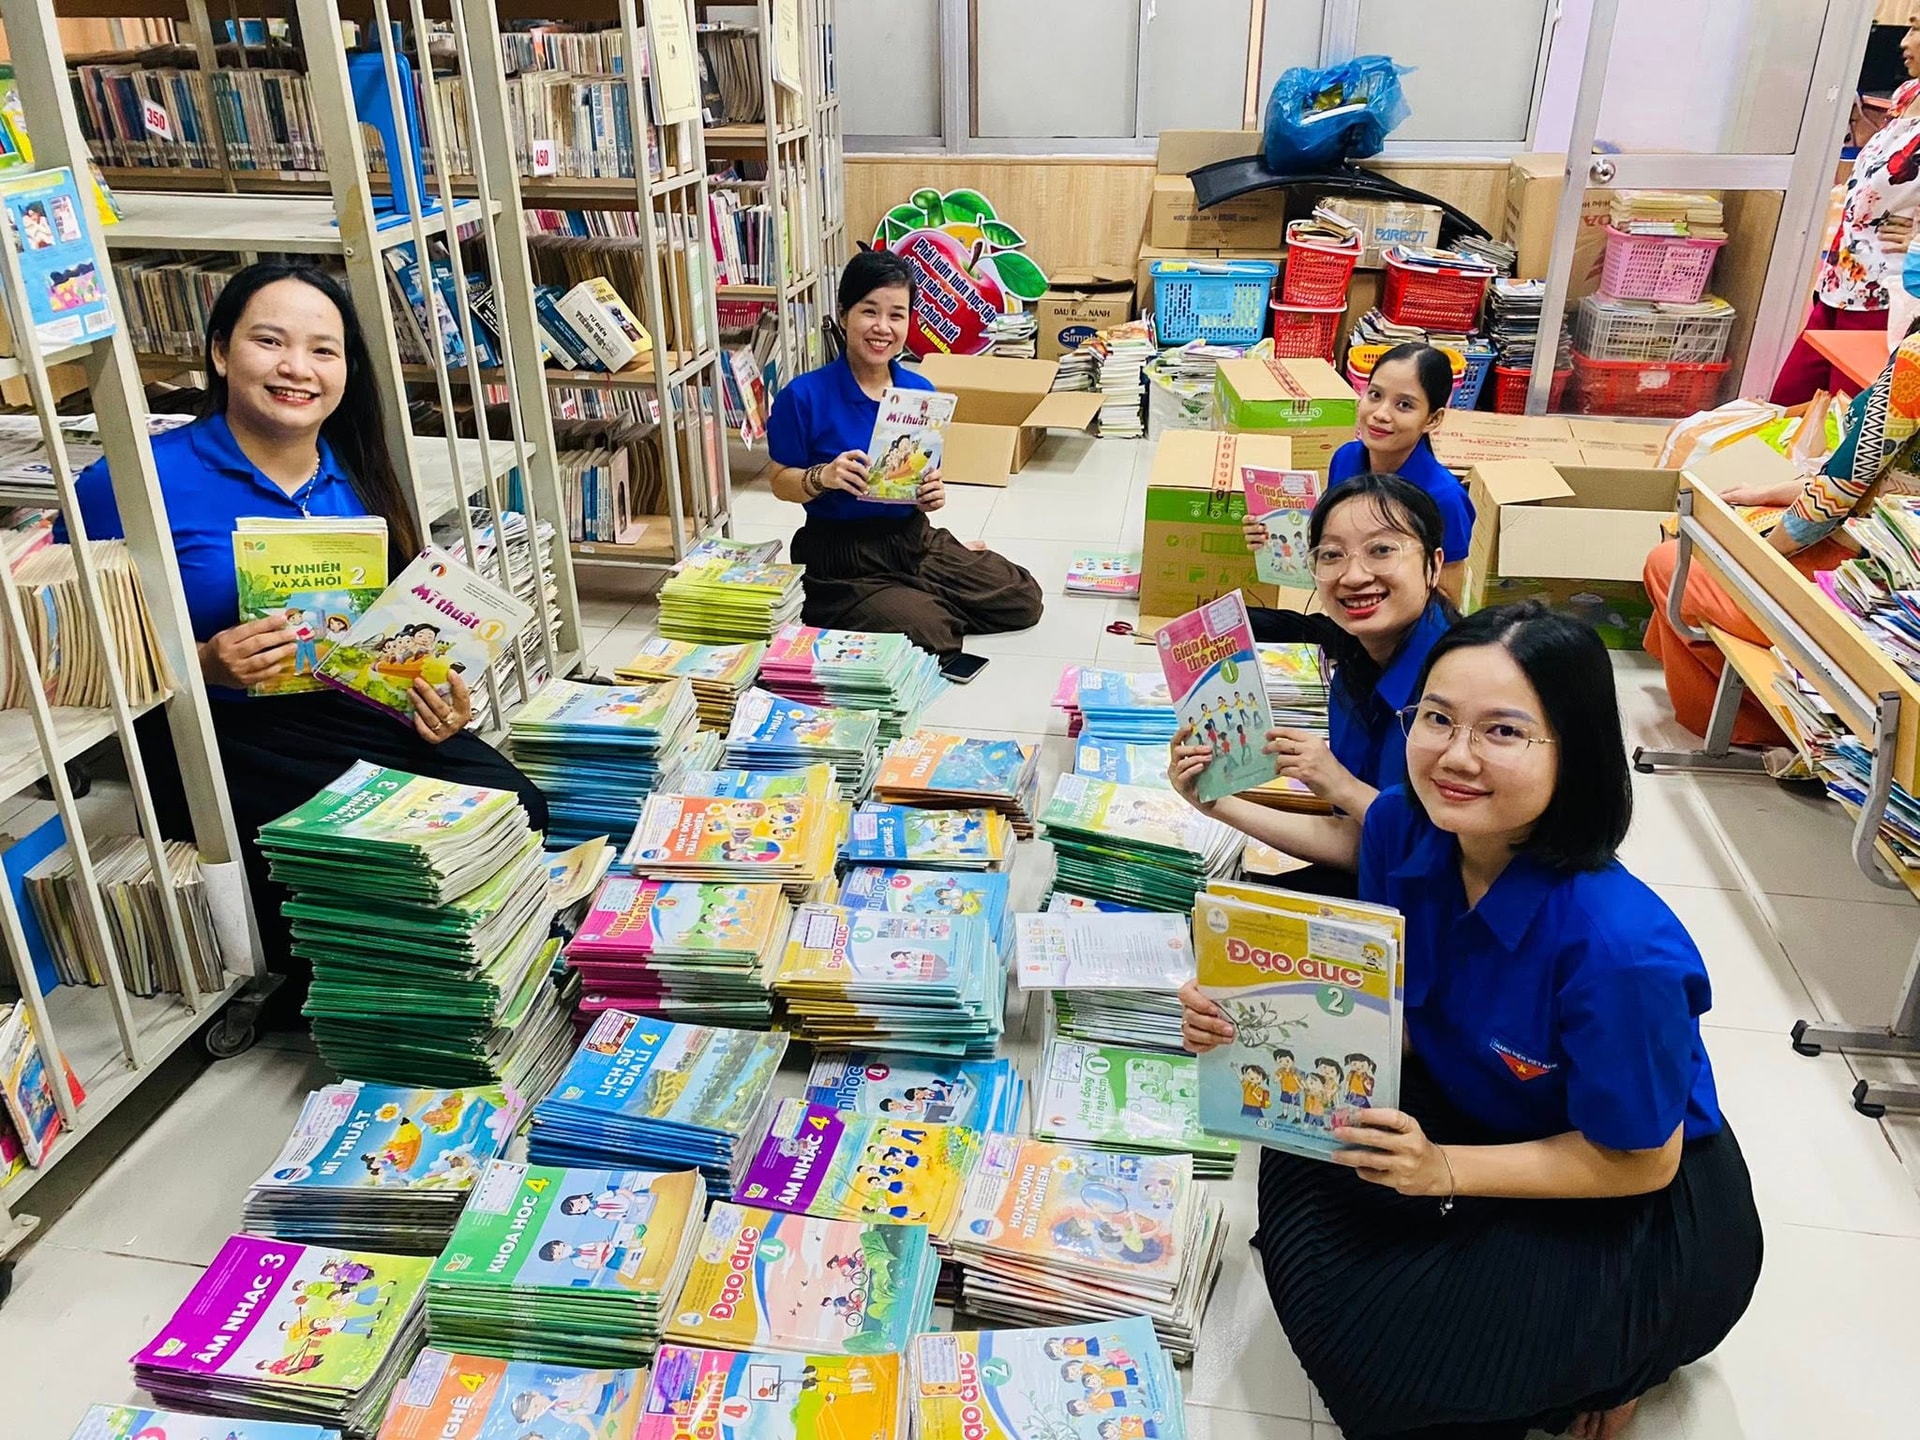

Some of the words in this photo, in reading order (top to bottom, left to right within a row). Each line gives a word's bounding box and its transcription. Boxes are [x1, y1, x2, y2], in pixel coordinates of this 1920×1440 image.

[146, 108, 166, 130] 350
[535, 149, 549, 167] 450
[1375, 227, 1428, 243] PARROT
[924, 274, 941, 295] nào
[938, 289, 958, 313] còn
[932, 256, 953, 279] luôn
[949, 272, 970, 297] luôn
[966, 288, 983, 310] học
[919, 302, 943, 327] chưa
[938, 318, 960, 342] biết
[1291, 512, 1300, 525] 2
[270, 563, 292, 578] TỰ
[294, 560, 341, 575] NHIÊN
[273, 579, 288, 589] VÀ
[291, 575, 311, 588] XÃ
[314, 573, 342, 589] HỘI
[350, 566, 367, 586] 2
[411, 583, 441, 604] Mĩ
[435, 598, 481, 630] thuật
[486, 624, 500, 640] 1
[1172, 639, 1201, 662] Giáo
[1227, 662, 1236, 681] 1
[910, 754, 932, 778] TOÁN
[923, 747, 937, 757] 3
[377, 780, 399, 790] 3
[715, 774, 731, 783] 2
[679, 812, 693, 833] ĐỘNG
[690, 812, 706, 840] NGHIỆM
[879, 817, 896, 825] 3
[675, 832, 689, 851] HOẠT
[686, 839, 699, 856] TRẢI
[866, 877, 891, 899] học
[894, 876, 908, 887] 3
[657, 898, 677, 907] 3
[853, 930, 872, 939] 3
[827, 948, 845, 969] Đạo
[1225, 937, 1294, 974] Đạo
[1326, 987, 1344, 1013] 2
[639, 1033, 661, 1046] 4
[634, 1049, 653, 1062] LÍ
[1089, 1061, 1109, 1069] 1
[595, 1066, 625, 1096] LỊCH
[615, 1047, 636, 1067] SỬ
[619, 1064, 645, 1087] ĐỊA
[836, 1065, 866, 1098] học
[868, 1067, 886, 1078] 4
[613, 1087, 630, 1098] VÀ
[808, 1115, 831, 1131] 4
[318, 1156, 340, 1177] MĨ
[337, 1108, 373, 1159] THUẬT
[793, 1133, 824, 1181] NHẠC
[525, 1177, 552, 1195] 4
[773, 1180, 804, 1206] ÂM
[513, 1194, 541, 1232] HỌC
[486, 1229, 521, 1274] KHOA
[762, 1241, 783, 1259] 4
[706, 1266, 747, 1321] Đạo
[191, 1333, 234, 1365] ÂM
[227, 1273, 275, 1328] NHẠC
[257, 1252, 287, 1270] 3
[981, 1363, 1009, 1378] 2
[457, 1371, 487, 1393] 4
[723, 1403, 749, 1419] 4
[961, 1405, 990, 1440] ạo
